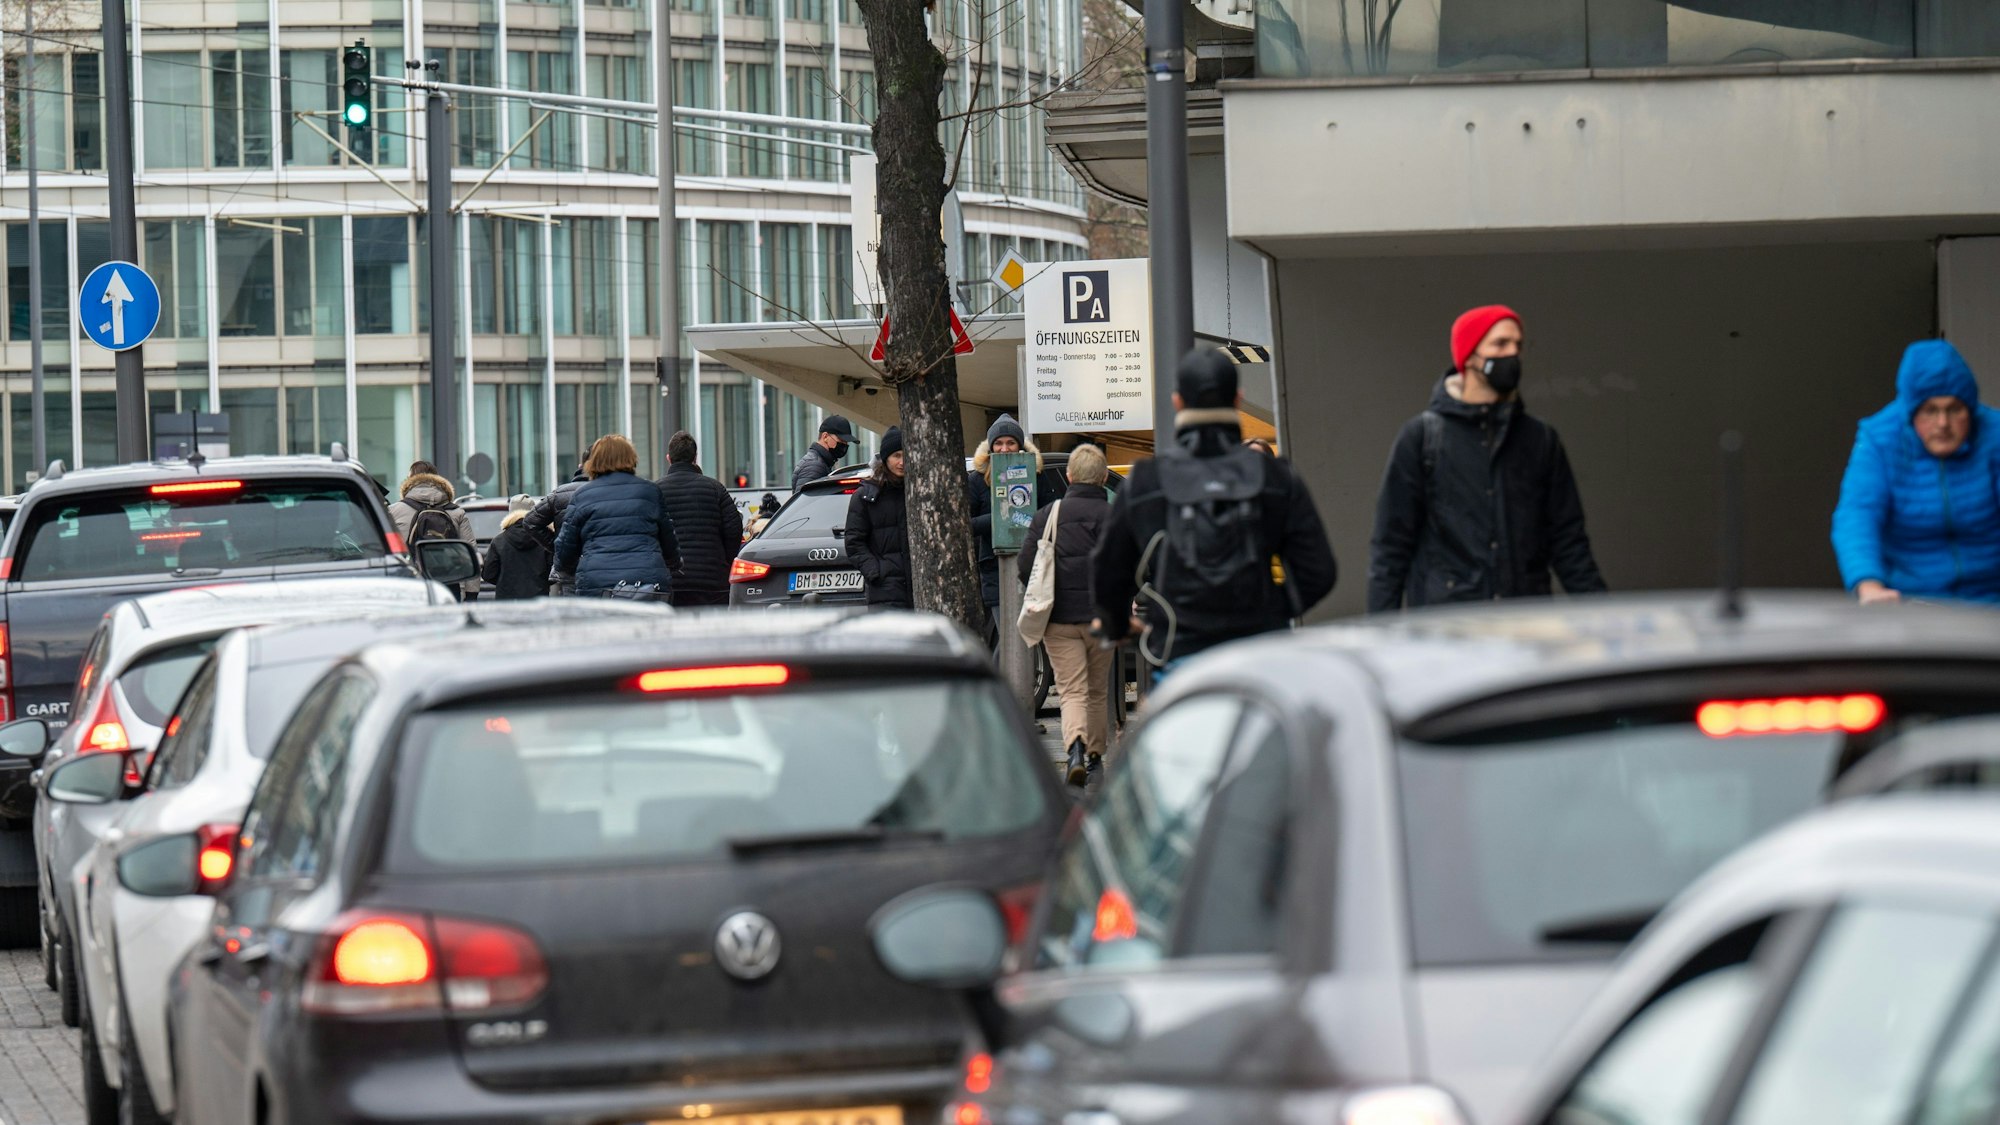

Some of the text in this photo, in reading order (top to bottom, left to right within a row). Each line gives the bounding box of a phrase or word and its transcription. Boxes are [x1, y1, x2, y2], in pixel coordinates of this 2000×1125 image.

[1036, 330, 1140, 346] ÖFFNUNGSZEITEN
[1036, 354, 1058, 362] Montag
[1063, 353, 1096, 361] Donnerstag
[1036, 367, 1057, 375] Freitag
[1037, 380, 1062, 388] Samstag
[1037, 390, 1142, 401] Sonntag geschlossen
[1055, 411, 1087, 422] GALERIA
[797, 572, 864, 589] BM DS 2907
[26, 702, 71, 716] GART
